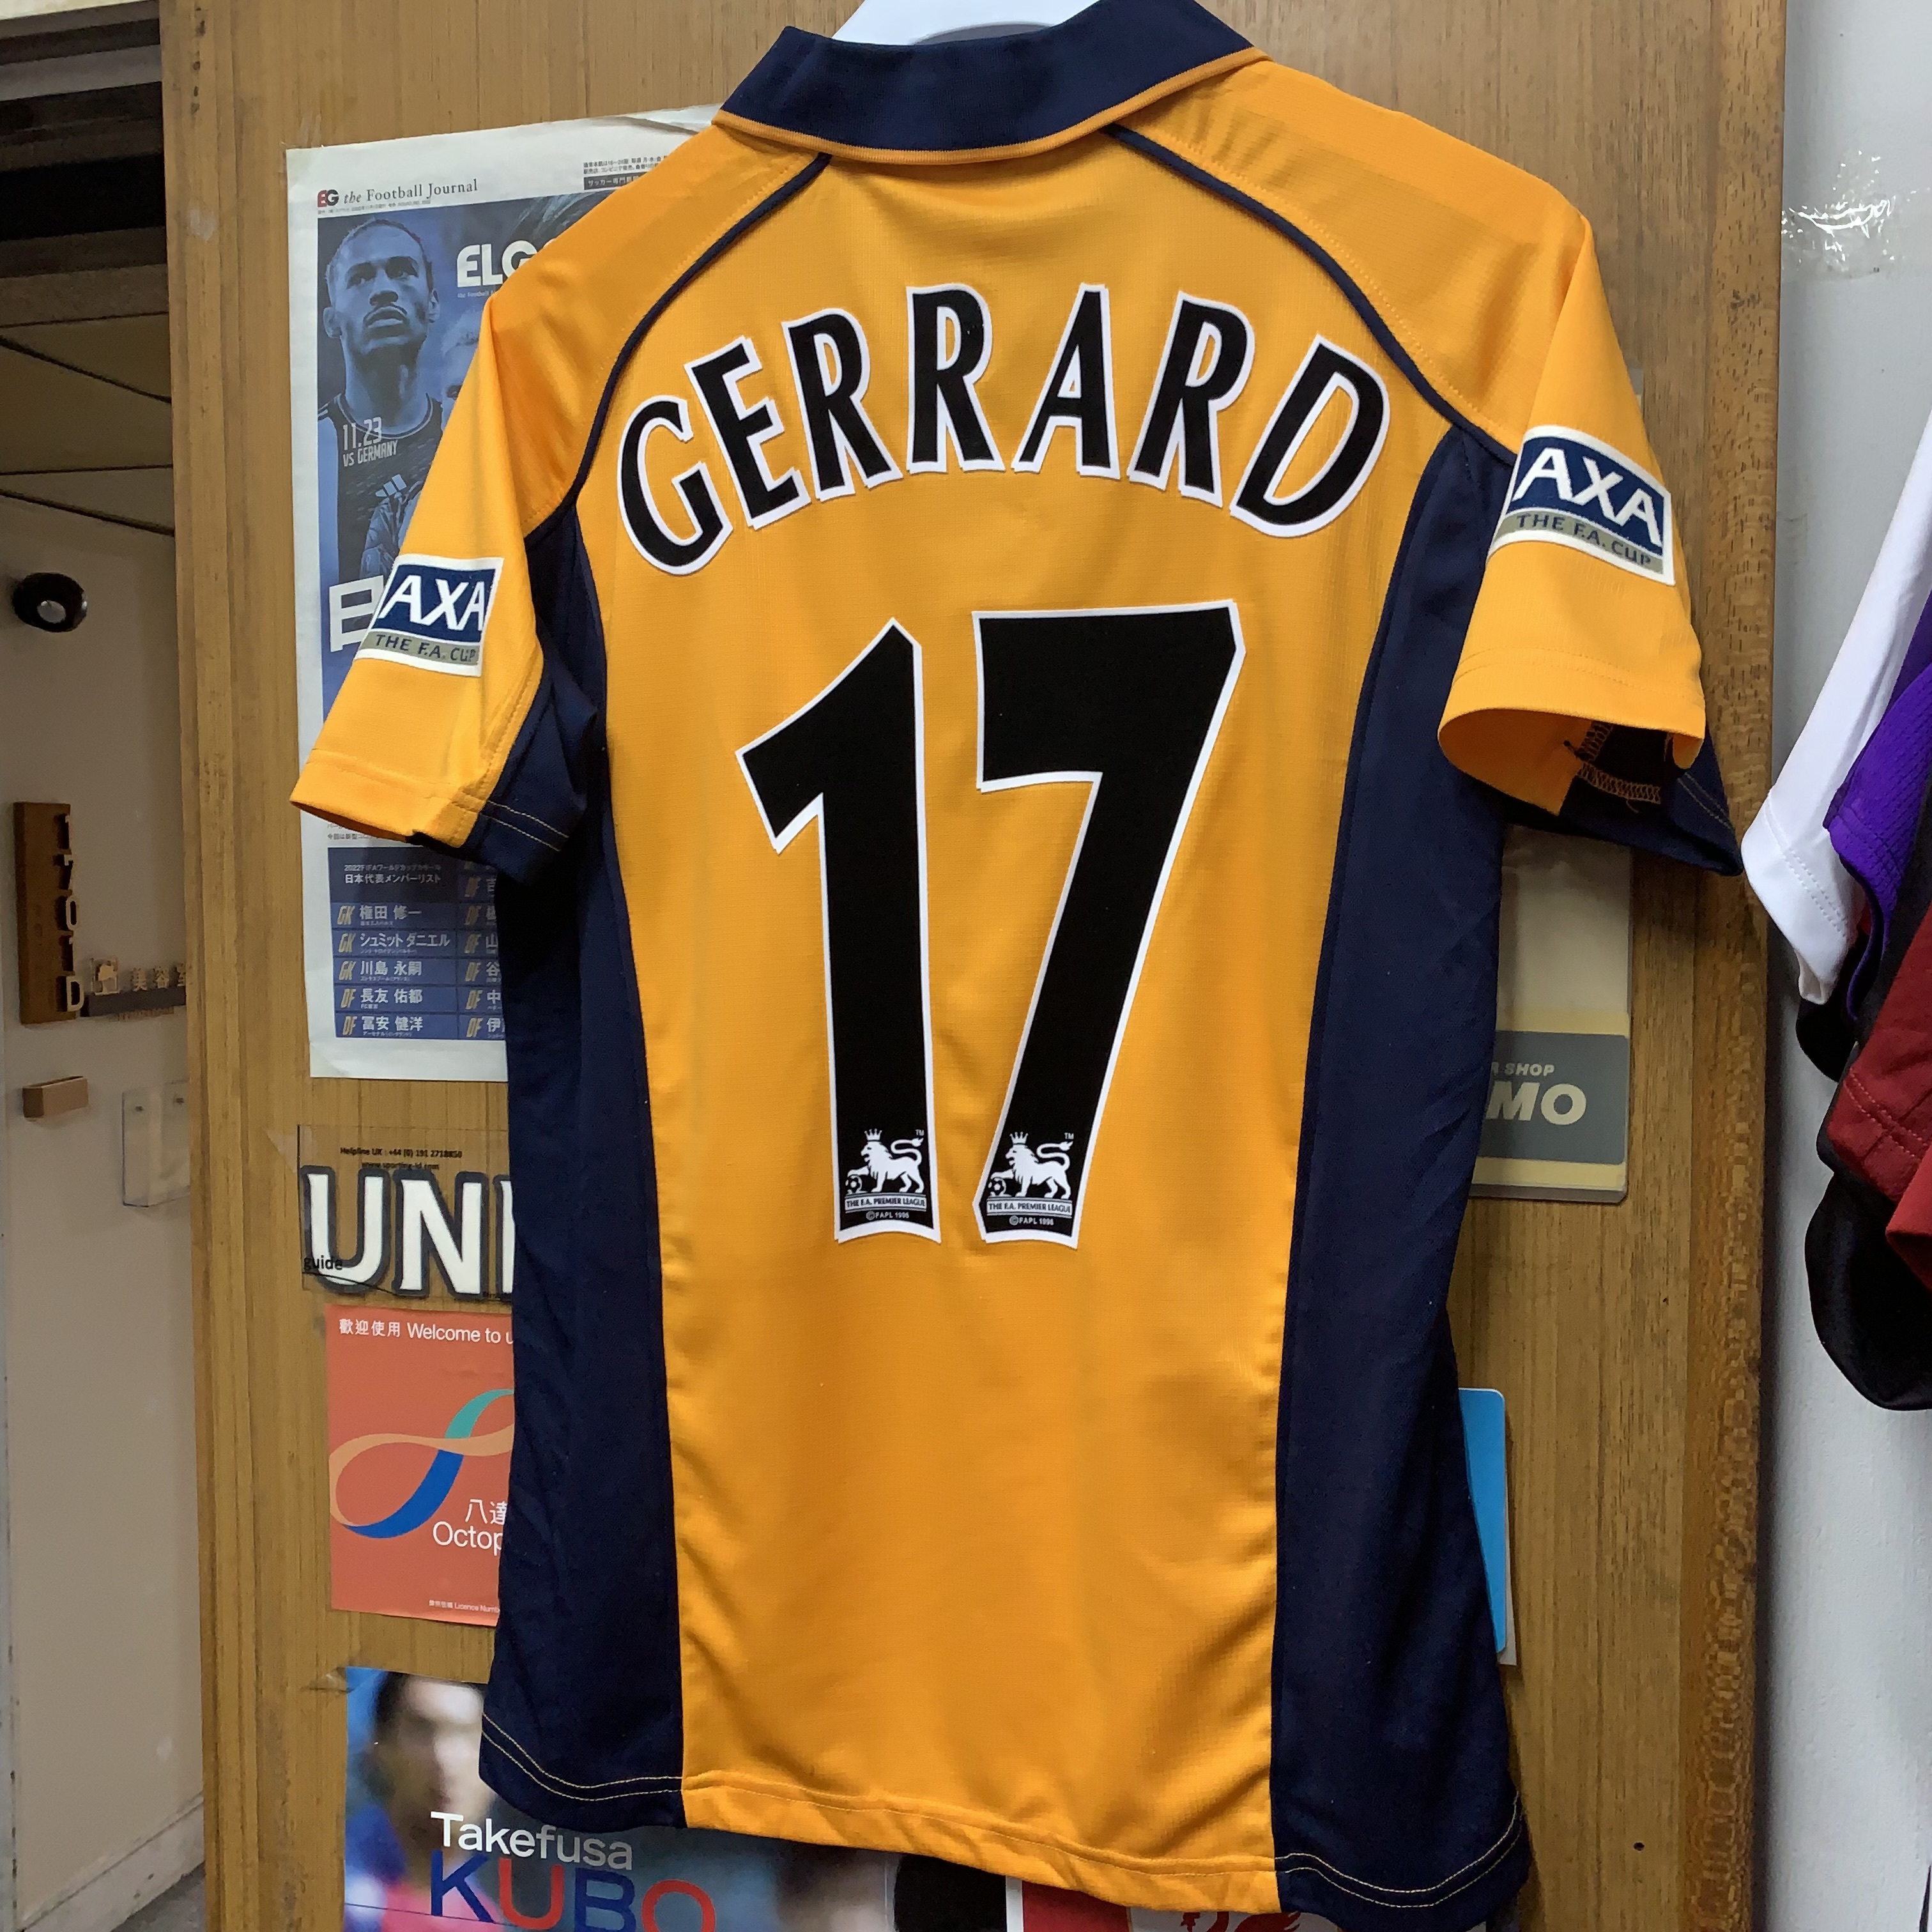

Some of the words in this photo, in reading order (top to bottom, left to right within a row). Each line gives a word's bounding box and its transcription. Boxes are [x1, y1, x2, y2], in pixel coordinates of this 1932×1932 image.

[317, 189, 339, 208] EG
[344, 191, 361, 204] the
[367, 183, 422, 201] Football
[427, 179, 478, 199] Journal
[457, 238, 556, 288] ELG
[342, 416, 382, 450] 11.23
[616, 282, 1392, 575] GERRARD
[342, 452, 355, 467] VS
[357, 440, 398, 464] GERMANY
[1512, 447, 1663, 548] AXA
[1516, 512, 1565, 530] THE
[1574, 523, 1606, 548] F.A.
[1611, 542, 1651, 567] CUP
[378, 574, 487, 632] AXA
[376, 633, 410, 652] THE
[418, 641, 446, 660] F.A.
[450, 647, 477, 663] CUP
[344, 873, 441, 885] 日本代表メンバーリスト
[360, 905, 388, 920] 権田
[735, 599, 1246, 1249] 17
[360, 933, 403, 947] シュミット
[406, 933, 450, 947] ダニエル
[360, 960, 388, 976] 川島
[394, 960, 422, 976] 永嗣
[360, 988, 388, 1004] 長友
[394, 988, 422, 1004] 佑都
[395, 1016, 424, 1032] 健洋
[486, 1018, 505, 1032] 伊
[1504, 1062, 1554, 1077] SHOP
[1485, 1080, 1586, 1126] MO
[340, 1147, 370, 1156] Helpline
[372, 1148, 383, 1156] UK
[388, 1148, 401, 1157] +44
[415, 1149, 429, 1158] 191
[846, 1197, 859, 1207] THE
[903, 1198, 925, 1207] LEAGUE
[988, 1202, 1002, 1211] THE
[1018, 1202, 1046, 1211] PREMIER
[1047, 1204, 1071, 1213] LEAGUE
[303, 1255, 343, 1271] guide
[339, 1318, 401, 1338] 歡迎使用
[407, 1322, 480, 1343] Welcome
[484, 1329, 502, 1344] to
[433, 1521, 503, 1556] Octop
[454, 1602, 479, 1611] Licence
[430, 1811, 633, 1870] Takefusa
[430, 1850, 716, 1932] KUBO
